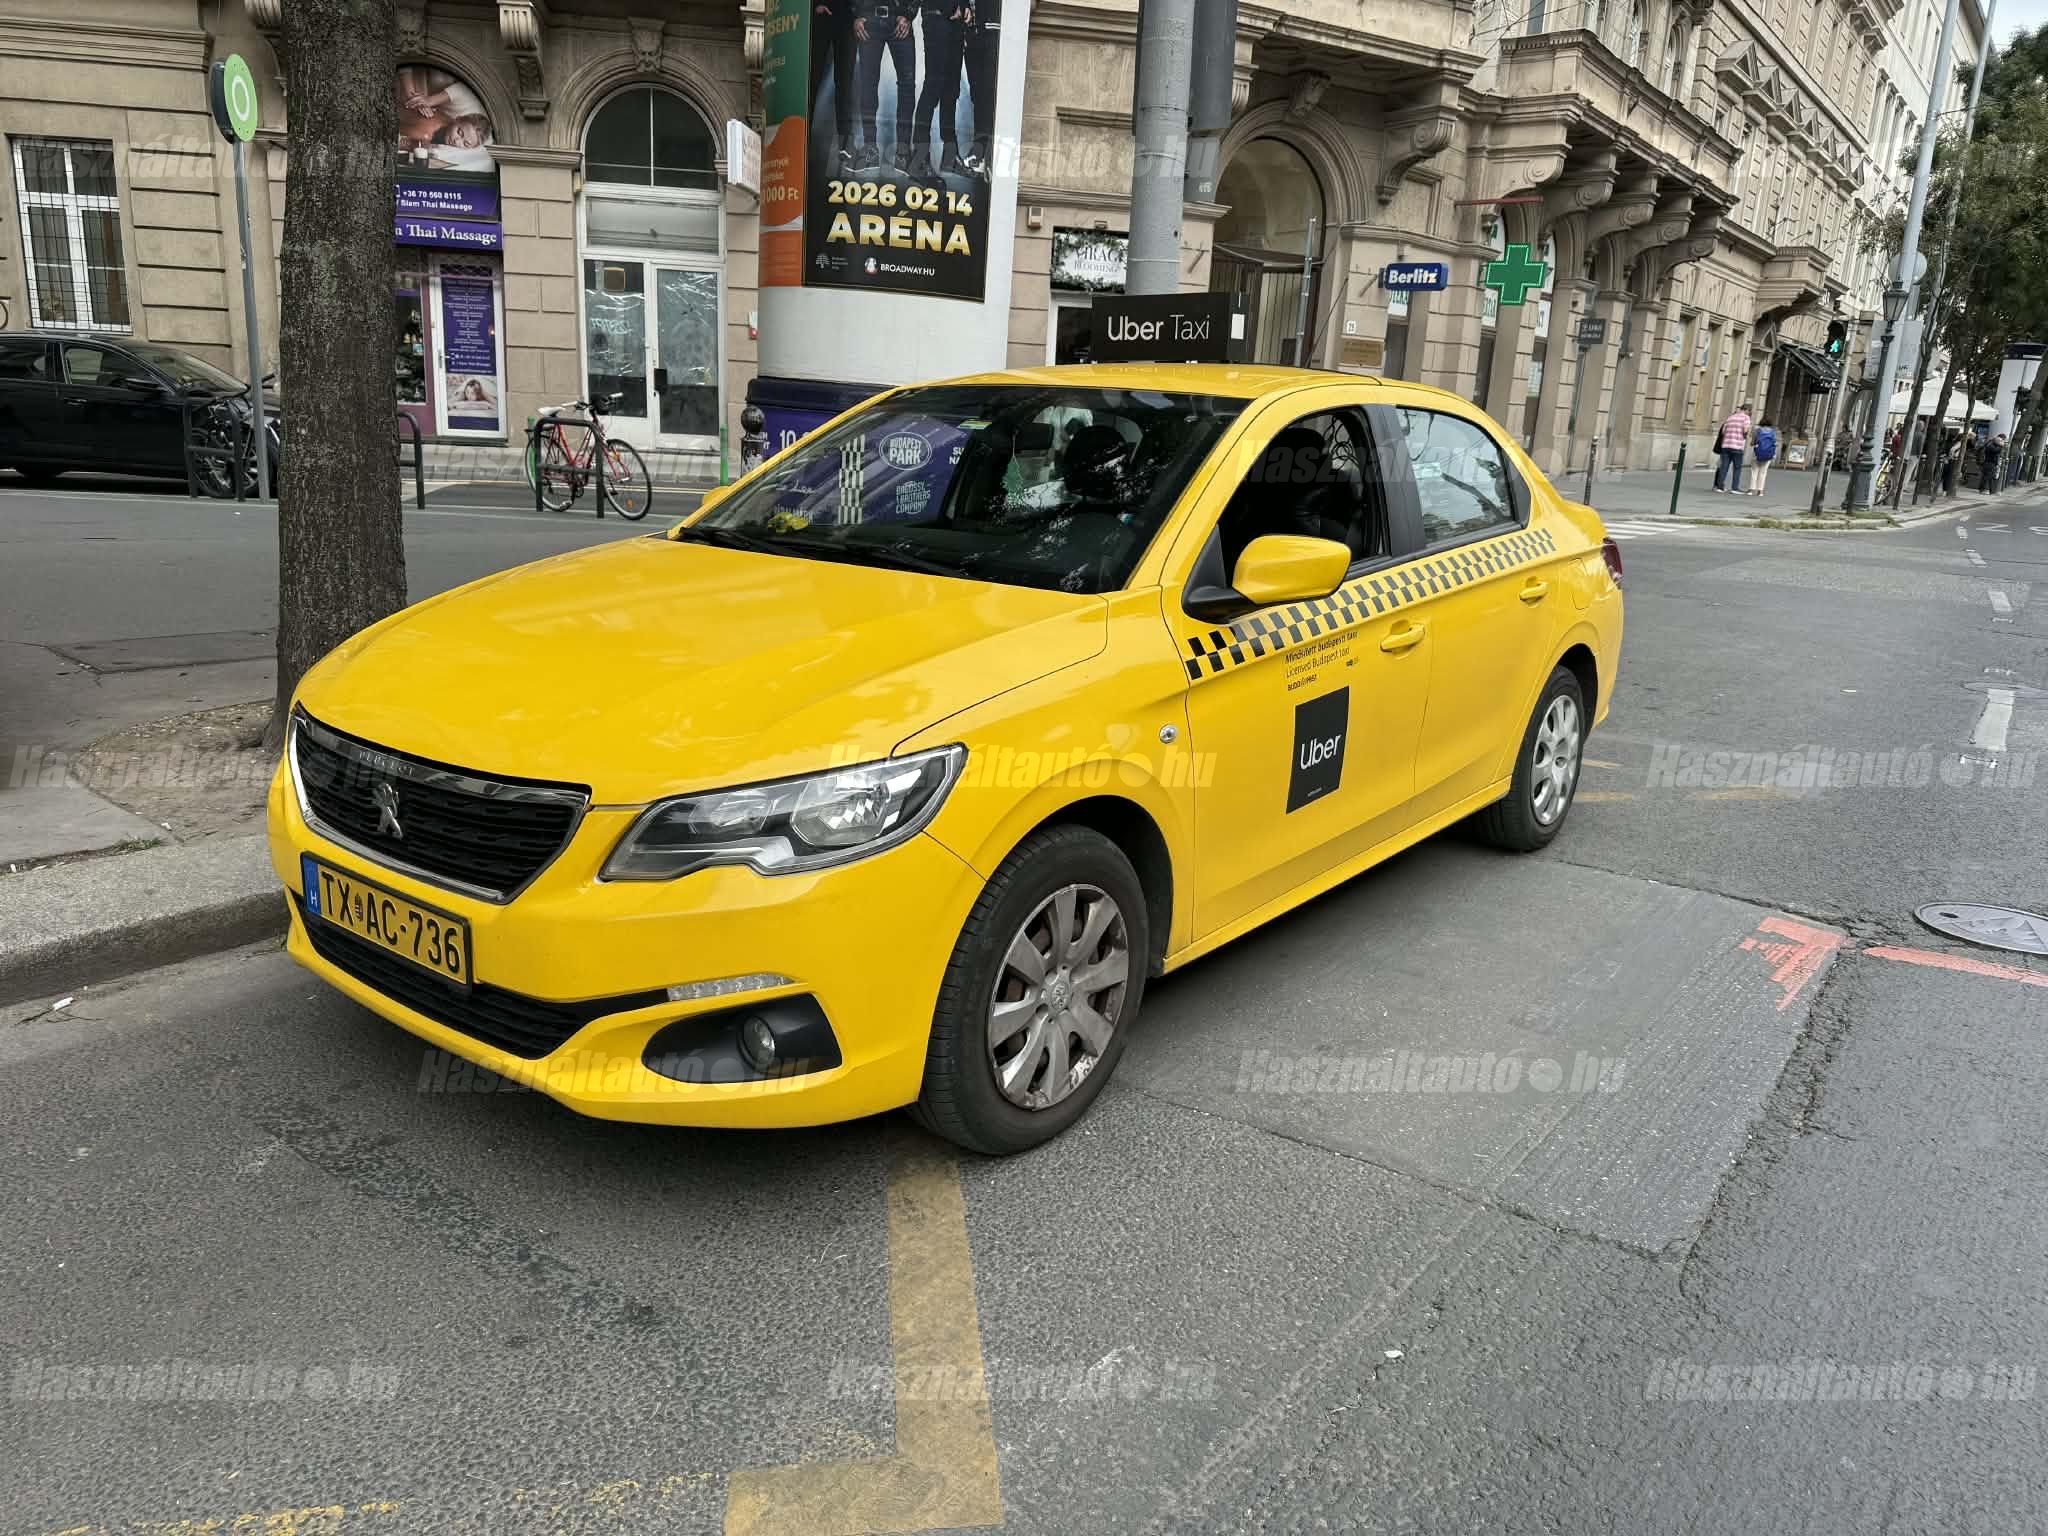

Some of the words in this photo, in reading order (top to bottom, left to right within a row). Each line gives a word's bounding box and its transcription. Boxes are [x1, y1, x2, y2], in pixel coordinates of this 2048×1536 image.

[421, 200, 438, 209] Thai
[439, 202, 473, 212] Massage
[828, 180, 897, 208] 2026
[905, 186, 939, 213] 02
[946, 191, 973, 217] 14
[406, 224, 437, 238] Thai
[440, 226, 497, 246] Massage
[826, 210, 972, 257] ARÉNA
[880, 263, 935, 277] BROADWAY.HU
[1388, 268, 1438, 284] Berlitz
[1107, 315, 1164, 341] Uber
[1169, 314, 1211, 340] Taxi
[889, 436, 921, 449] BUDAPEST
[889, 447, 921, 465] PARK
[1300, 734, 1342, 770] Uber
[310, 890, 318, 906] H
